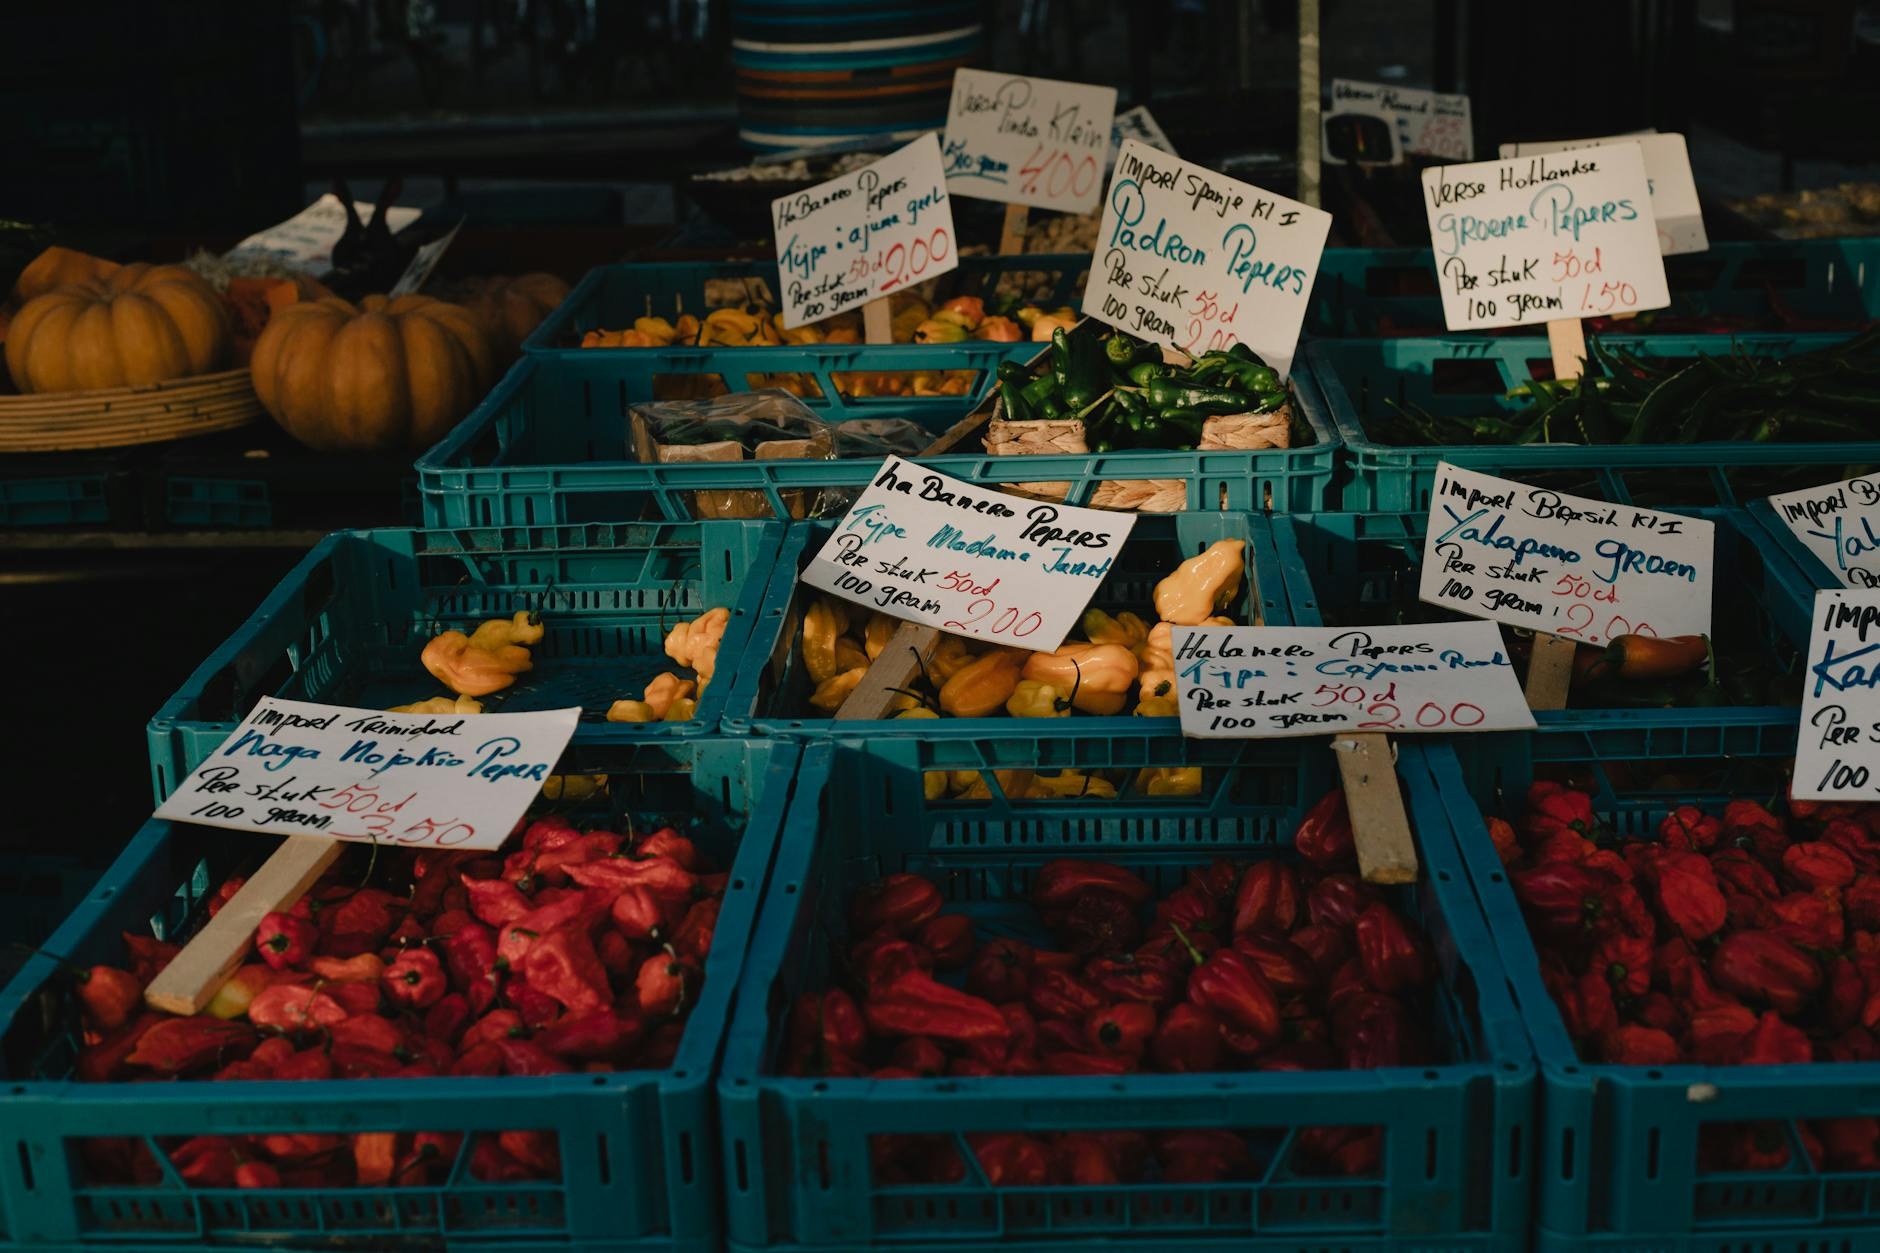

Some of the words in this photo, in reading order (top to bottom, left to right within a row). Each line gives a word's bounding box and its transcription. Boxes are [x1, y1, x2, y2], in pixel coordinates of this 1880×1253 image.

[1048, 102, 1103, 148] Klein
[802, 302, 825, 321] 100
[830, 287, 868, 312] gram
[1102, 294, 1127, 320] 100
[1130, 305, 1177, 341] gram
[1467, 298, 1497, 321] 100
[1506, 293, 1563, 321] gram
[1580, 280, 1638, 312] 1.50
[927, 523, 1031, 562] Madame
[834, 571, 872, 595] 100
[875, 585, 941, 615] gram
[944, 599, 1042, 637] 2.00
[1438, 578, 1474, 600] 100
[1480, 589, 1542, 615] gram
[1210, 714, 1255, 730] 100
[1269, 712, 1347, 729] gram
[1358, 702, 1485, 728] 2.00
[224, 729, 321, 771] Naga
[1817, 759, 1869, 792] 100
[190, 803, 243, 820] 100
[252, 807, 331, 831] gram
[329, 814, 475, 846] 3.50
